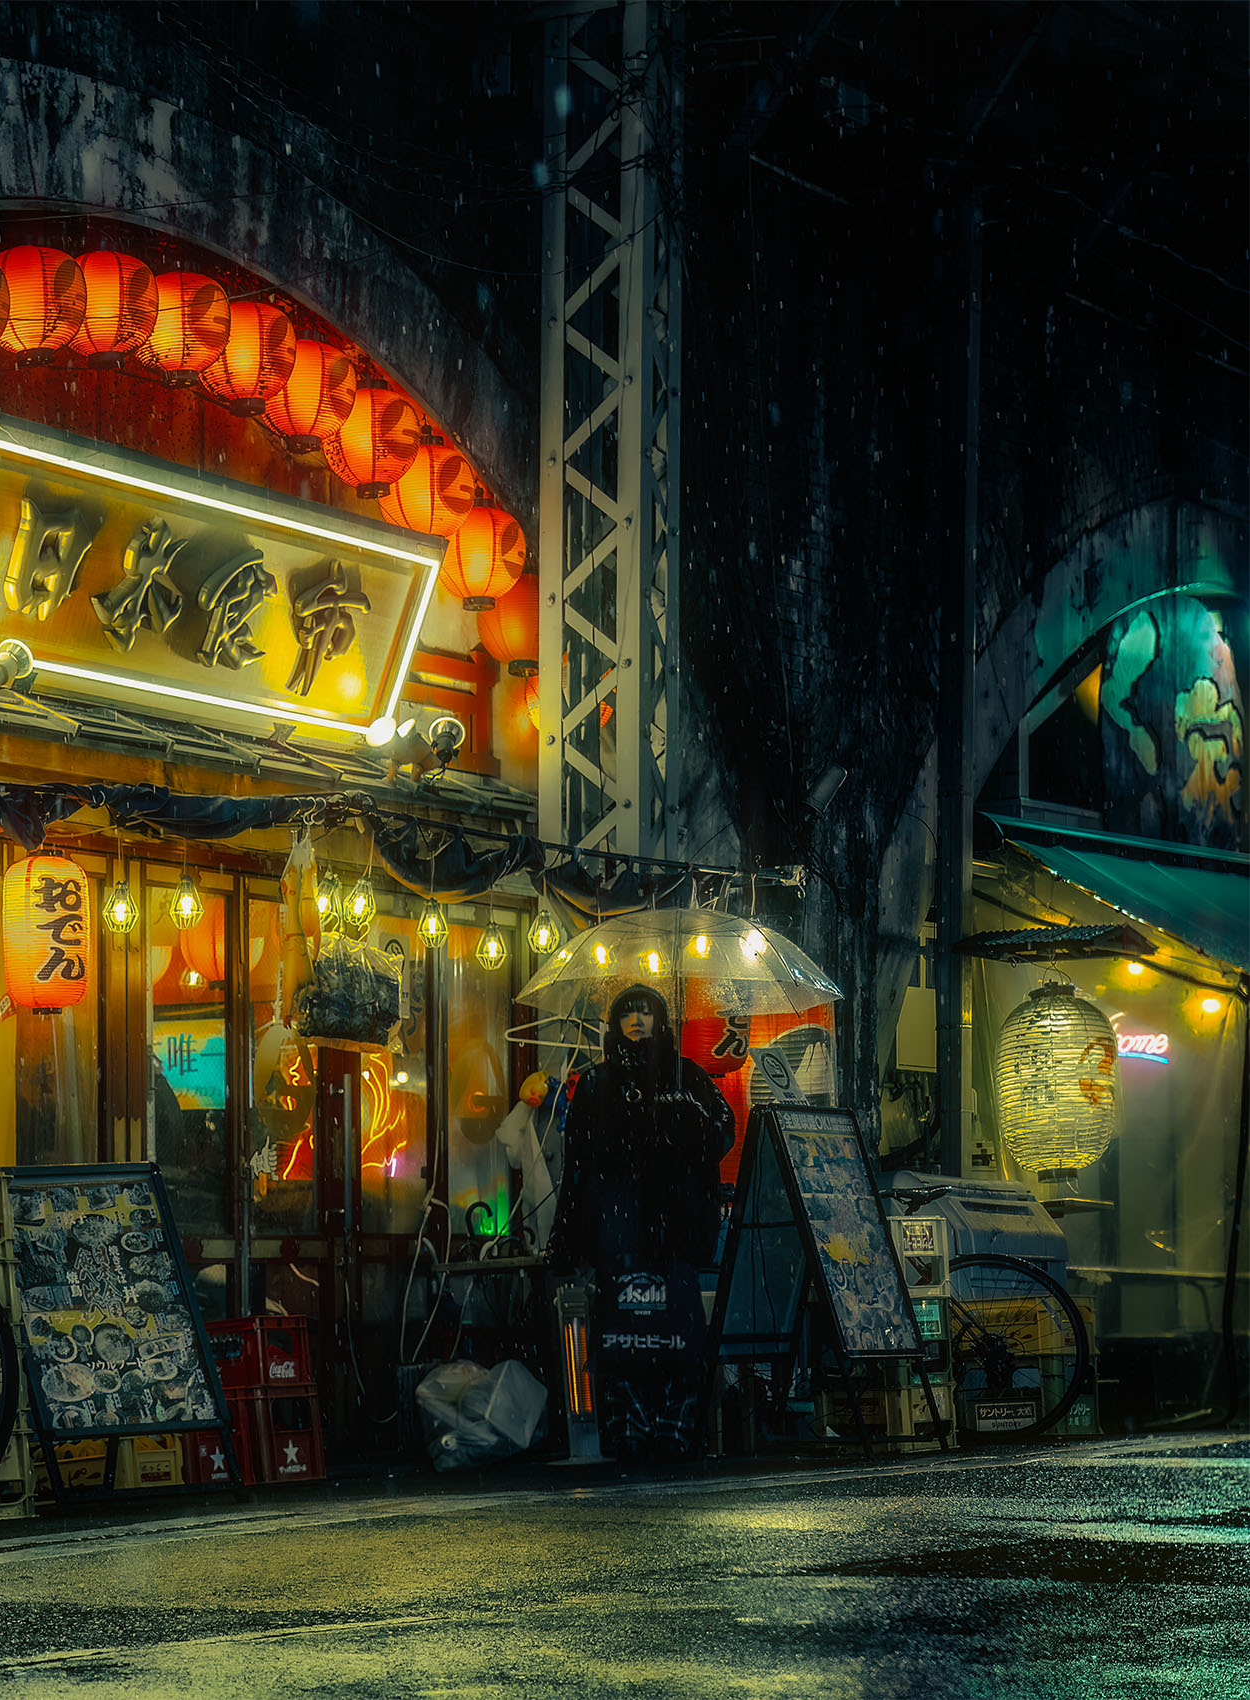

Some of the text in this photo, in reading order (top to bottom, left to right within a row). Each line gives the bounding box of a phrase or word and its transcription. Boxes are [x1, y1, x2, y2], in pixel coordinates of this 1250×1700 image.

[35, 876, 86, 982] おでん
[617, 1281, 667, 1304] Asahi
[602, 1332, 687, 1351] アサヒビール
